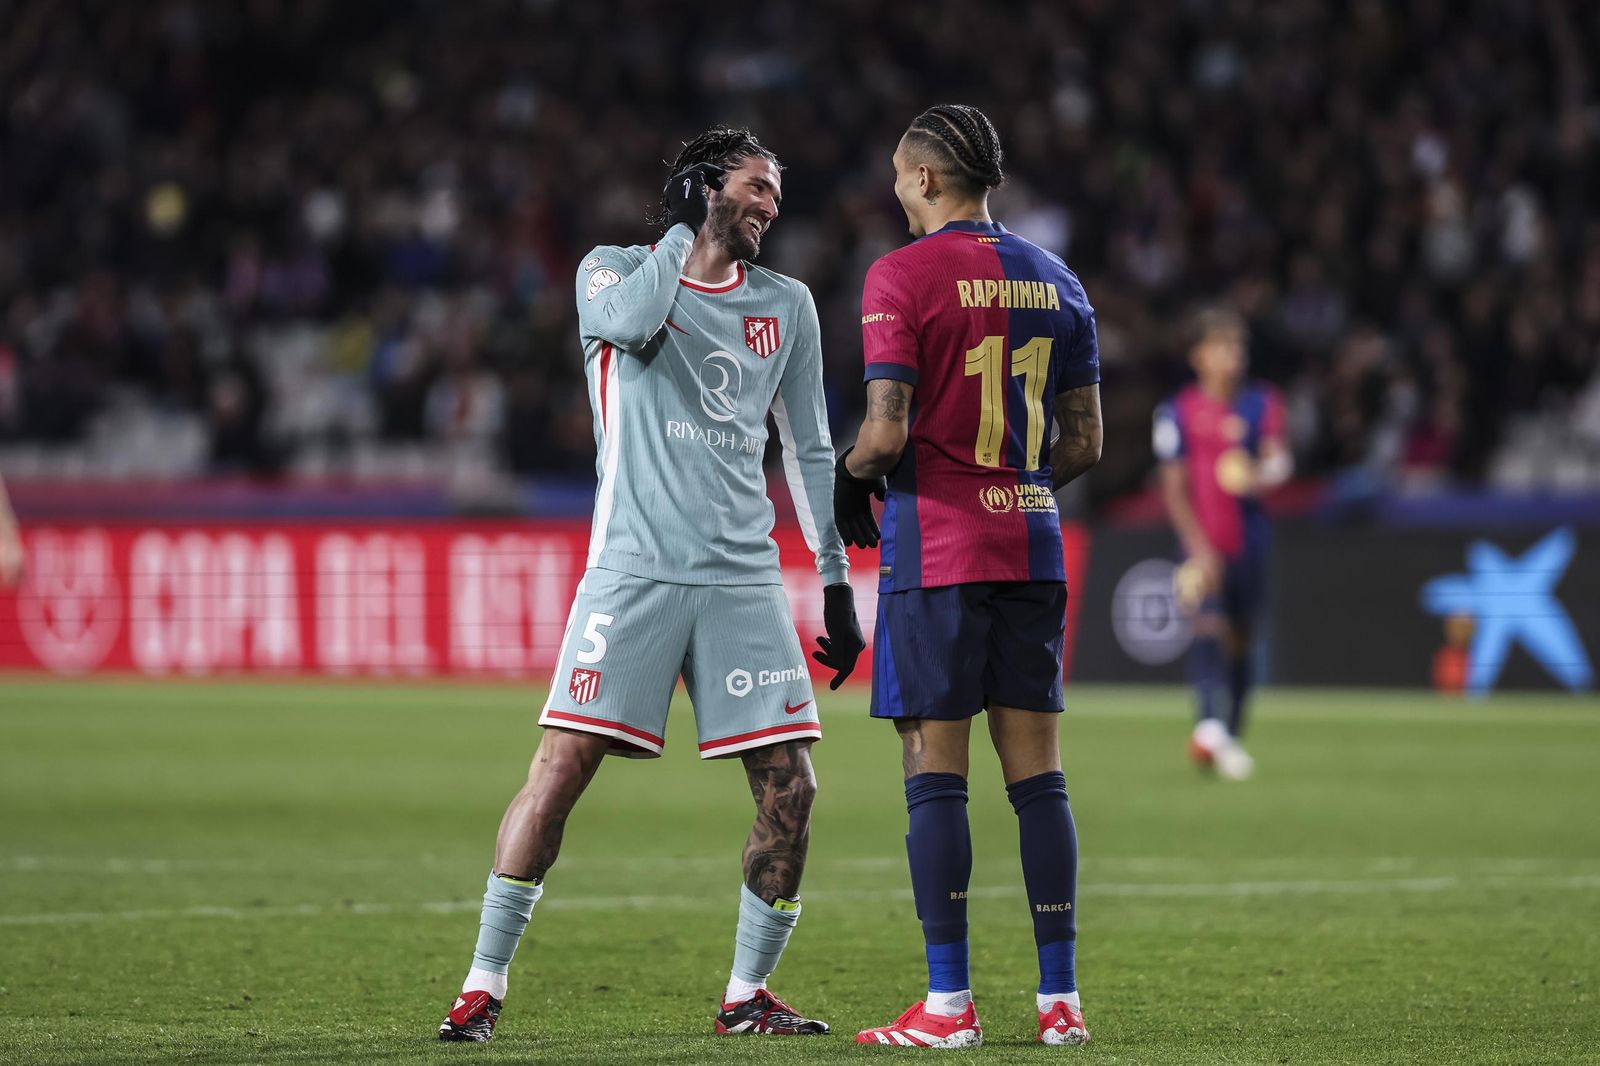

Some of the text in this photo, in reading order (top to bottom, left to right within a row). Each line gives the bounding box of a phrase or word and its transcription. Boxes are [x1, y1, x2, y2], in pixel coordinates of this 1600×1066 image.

[956, 279, 1060, 311] RAPHINHA
[862, 313, 884, 325] LIGHT
[964, 335, 1054, 472] 11
[666, 420, 762, 455] RIYADH AIR
[1017, 496, 1055, 508] ACNUR
[575, 611, 615, 664] 5
[1036, 902, 1072, 912] BARÇA
